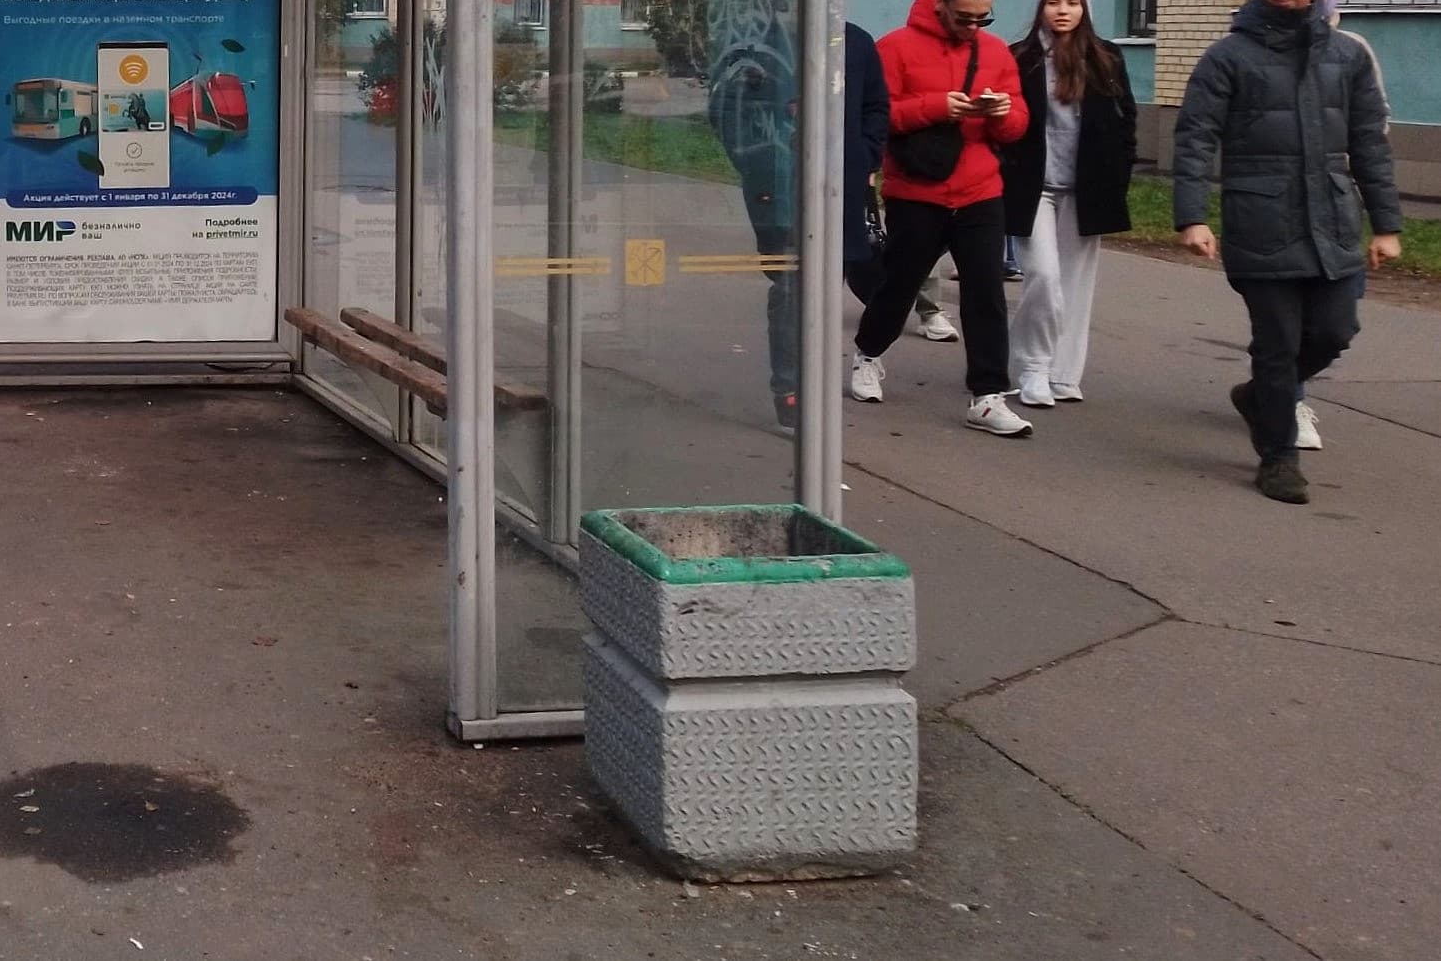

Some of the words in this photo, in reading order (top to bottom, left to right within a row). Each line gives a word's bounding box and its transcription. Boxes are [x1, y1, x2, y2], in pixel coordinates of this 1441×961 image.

[3, 15, 56, 25] Выгодные
[59, 15, 101, 24] поездки
[113, 15, 163, 24] наземном
[166, 14, 225, 25] транспорте
[23, 194, 52, 203] Акция
[53, 193, 99, 203] действует
[115, 193, 146, 202] января
[161, 192, 170, 200] 31
[171, 191, 209, 201] декабря
[81, 221, 141, 231] безналично
[205, 218, 258, 227] Подробнее
[6, 221, 76, 242] МИР
[81, 232, 102, 240] ваш
[192, 231, 204, 239] на
[206, 229, 258, 240] privetmir.ru
